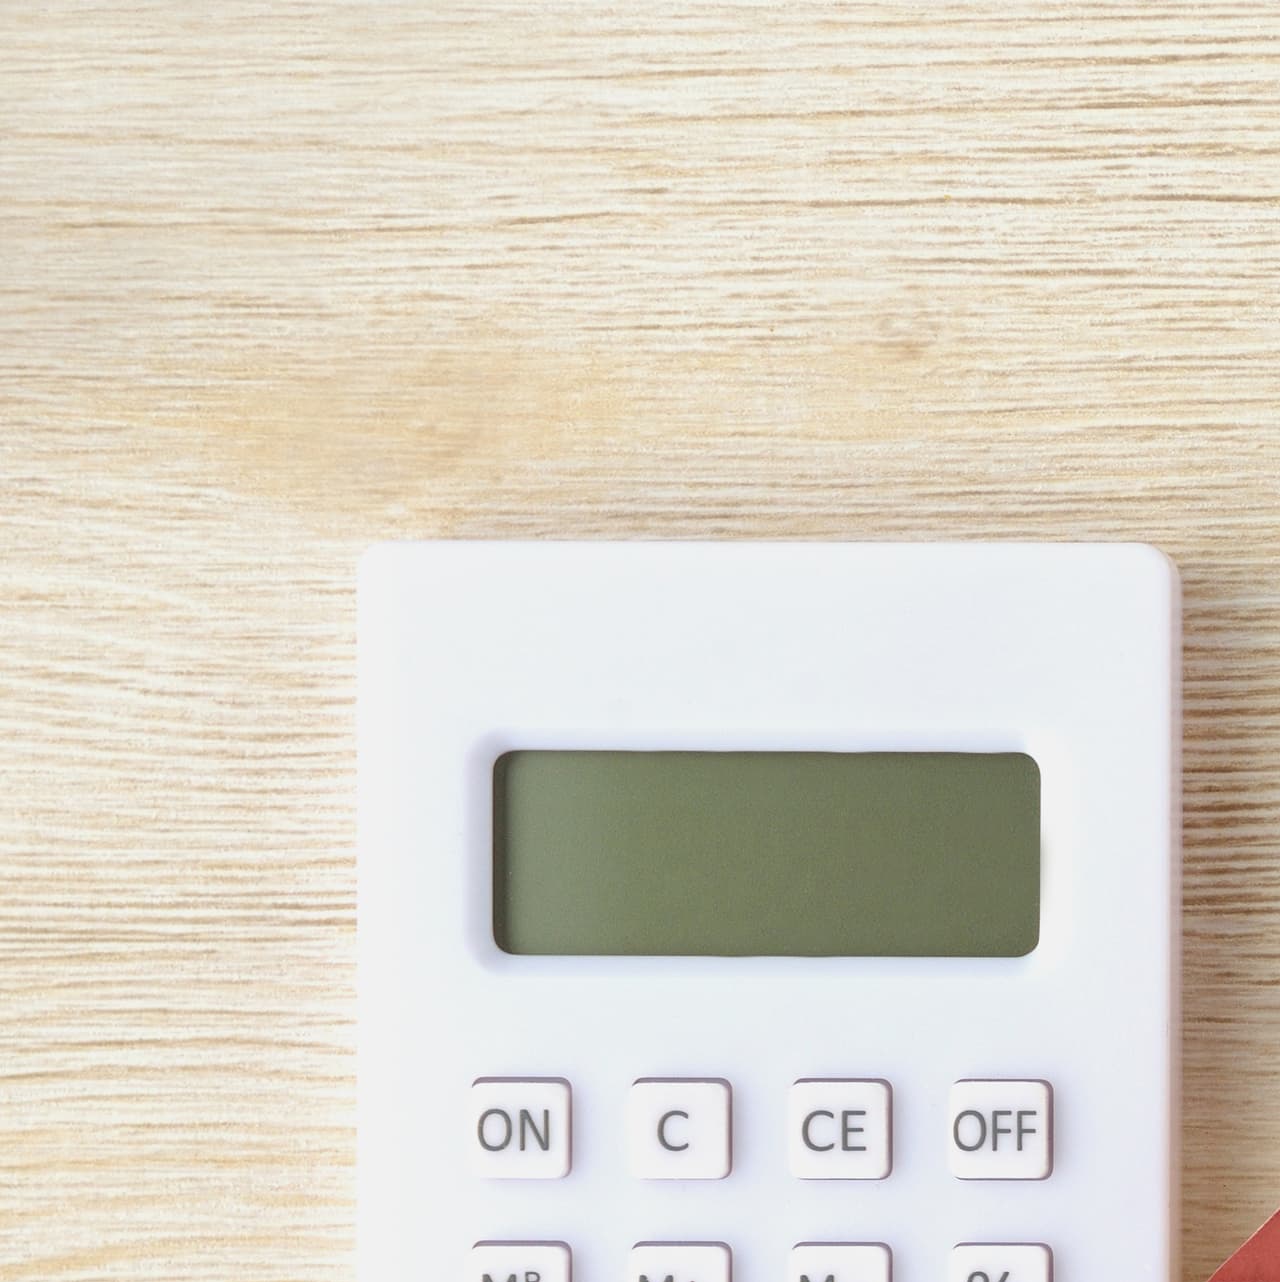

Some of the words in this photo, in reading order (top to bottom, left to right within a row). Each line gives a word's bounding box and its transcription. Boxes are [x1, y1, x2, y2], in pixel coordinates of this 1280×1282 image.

[477, 1107, 551, 1153] ON
[656, 1109, 690, 1153] C
[801, 1109, 868, 1153] CE
[952, 1109, 1038, 1153] OFF
